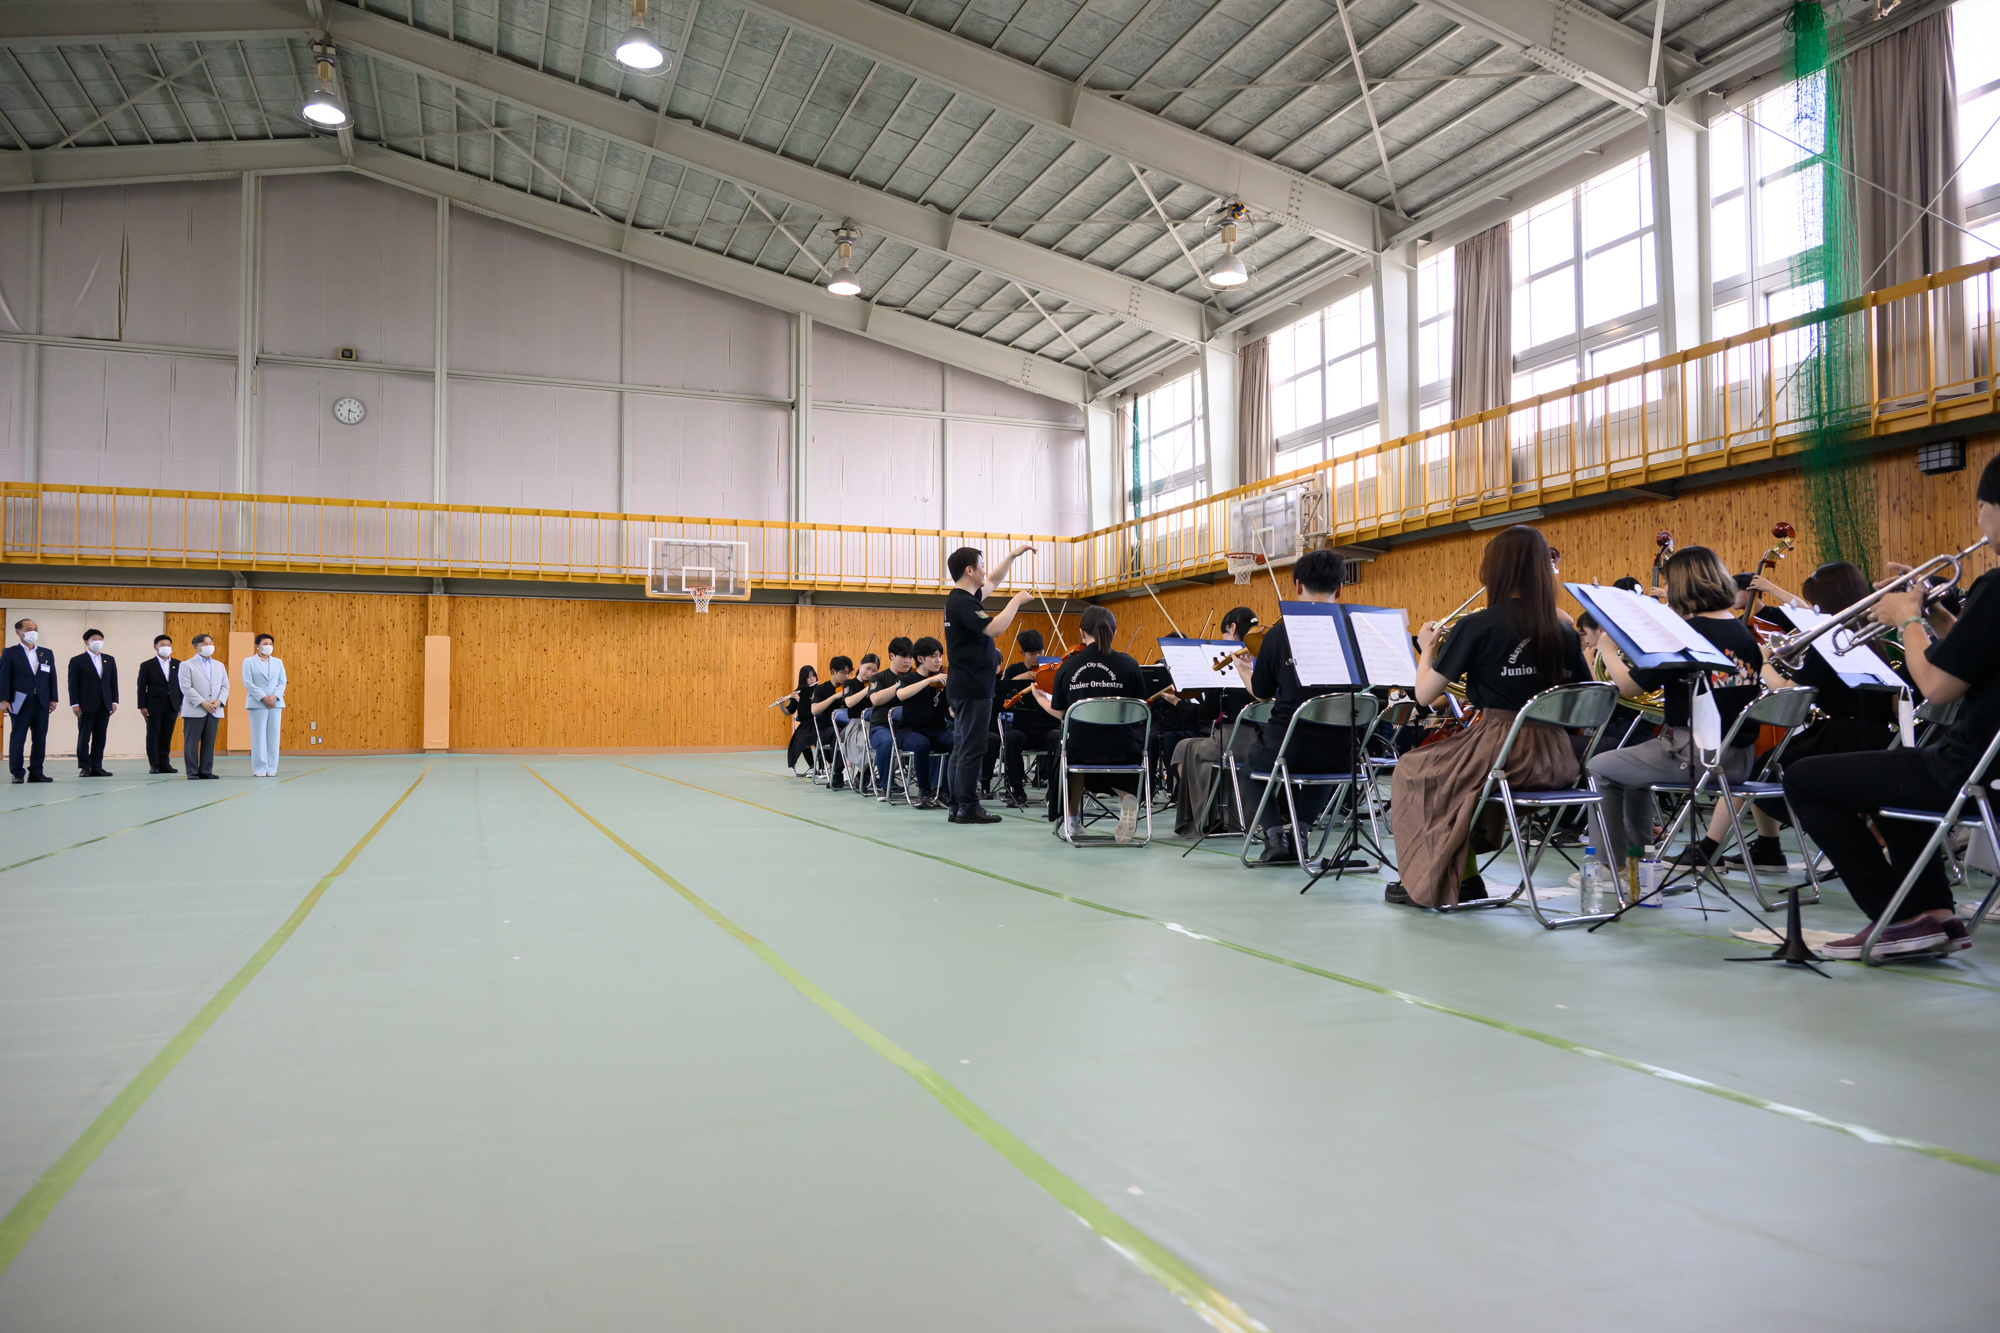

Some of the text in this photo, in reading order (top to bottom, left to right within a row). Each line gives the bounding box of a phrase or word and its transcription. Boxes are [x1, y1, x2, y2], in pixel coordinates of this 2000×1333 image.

[1097, 662, 1110, 671] Since
[1069, 680, 1123, 690] Junior Orchestra
